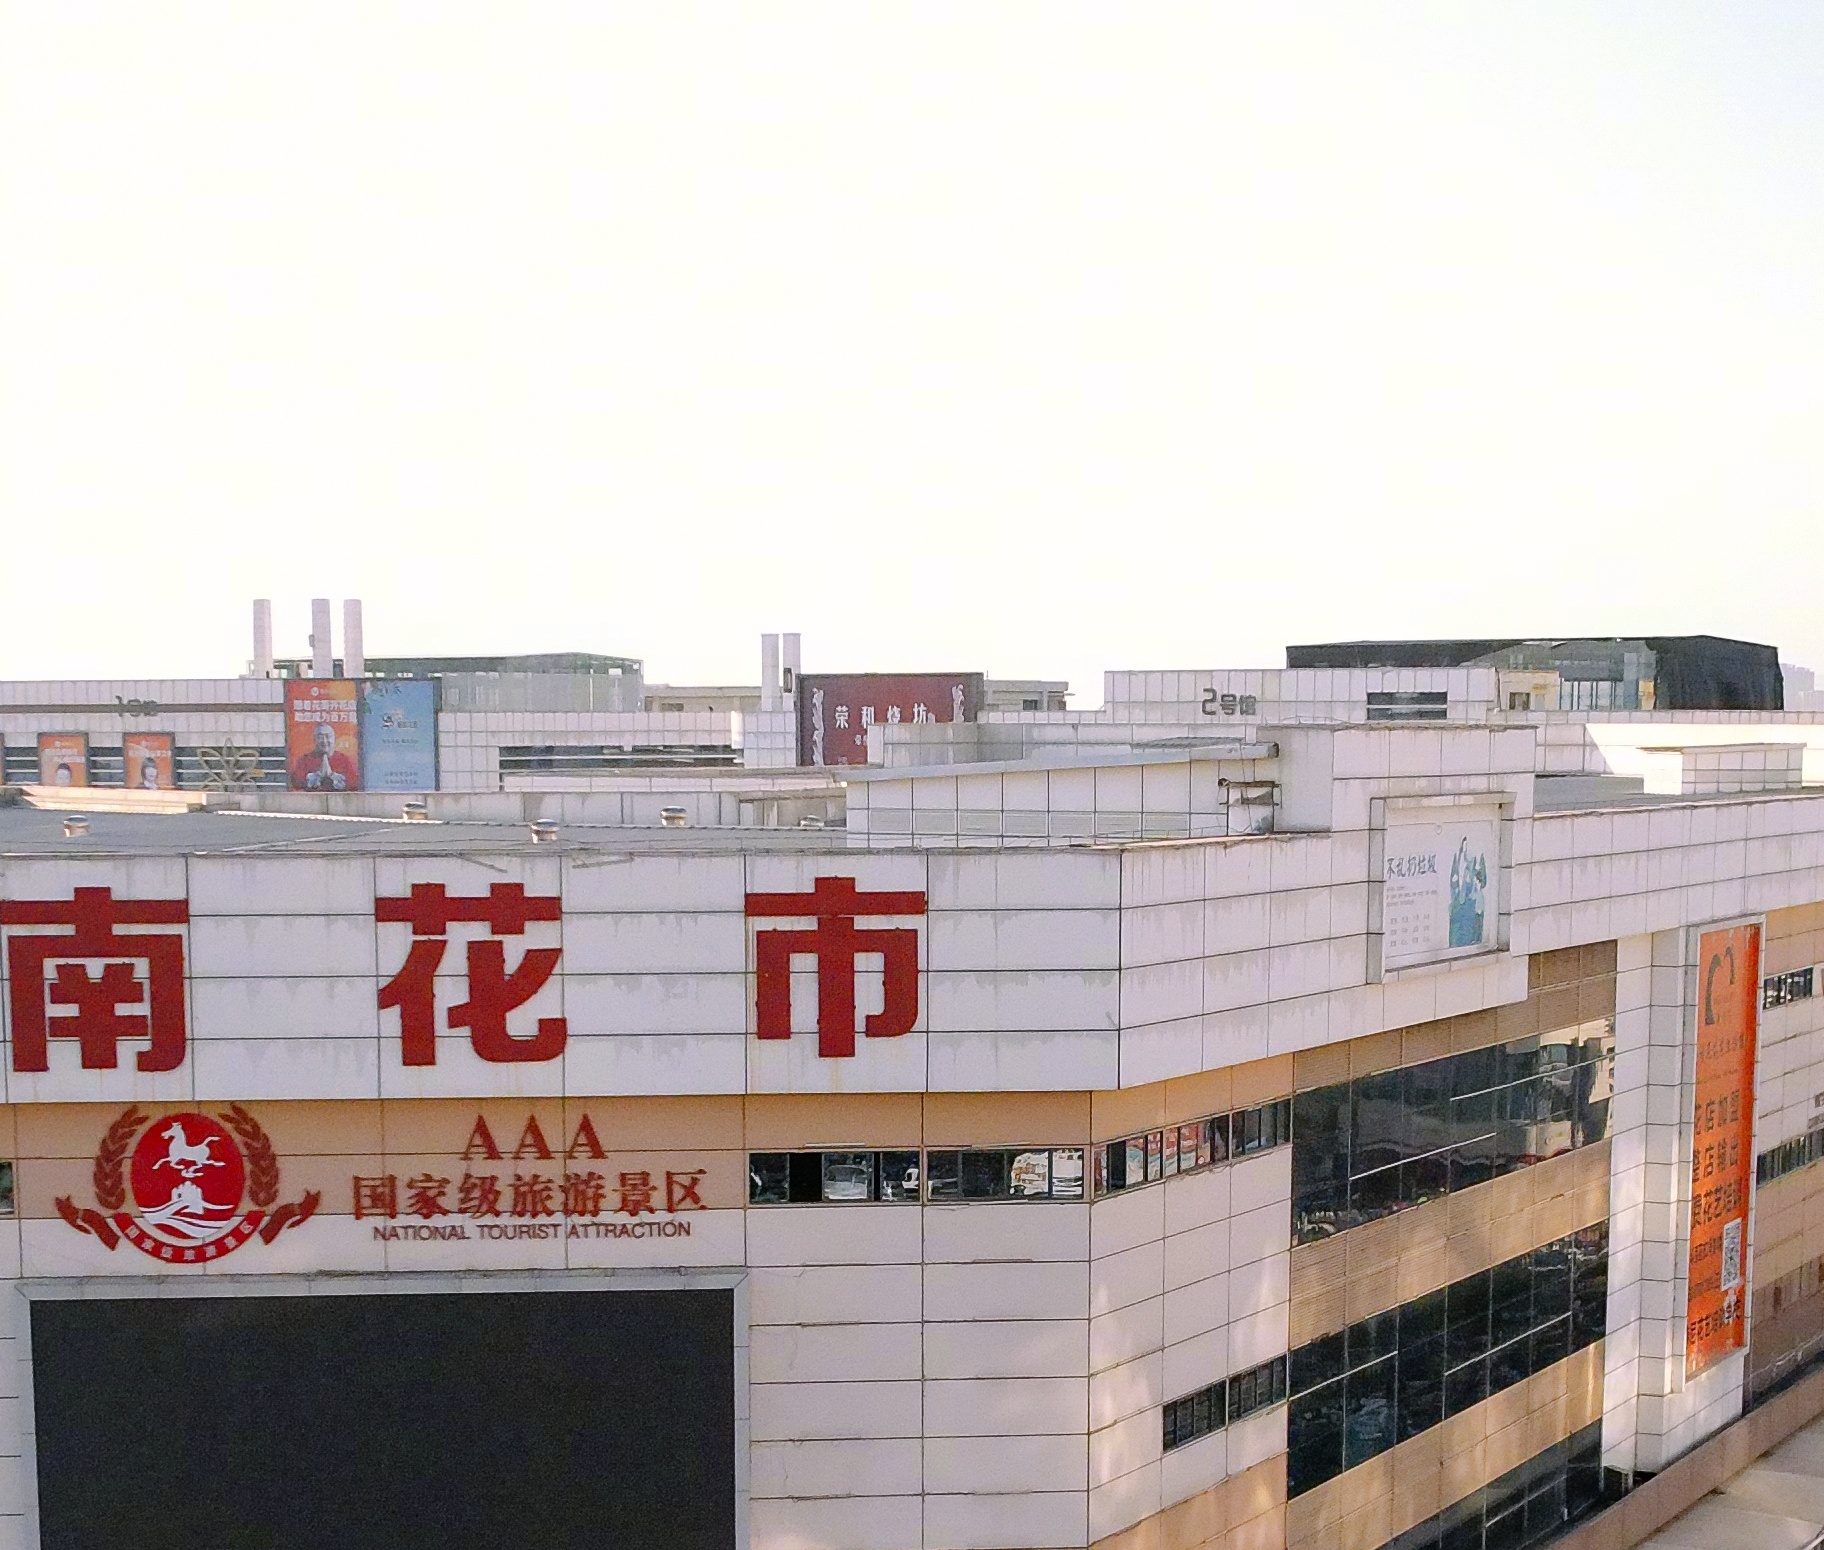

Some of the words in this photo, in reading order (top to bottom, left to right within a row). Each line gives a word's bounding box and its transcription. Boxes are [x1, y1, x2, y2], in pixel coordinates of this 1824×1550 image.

[1201, 687, 1257, 716] 2号馆
[1386, 854, 1437, 880] 不乱扔垃圾
[352, 1168, 708, 1220] 国家级旅游景区
[372, 1223, 472, 1241] NATIONAL
[478, 1222, 560, 1240] TOURIST
[567, 1221, 692, 1239] ATTRACTION
